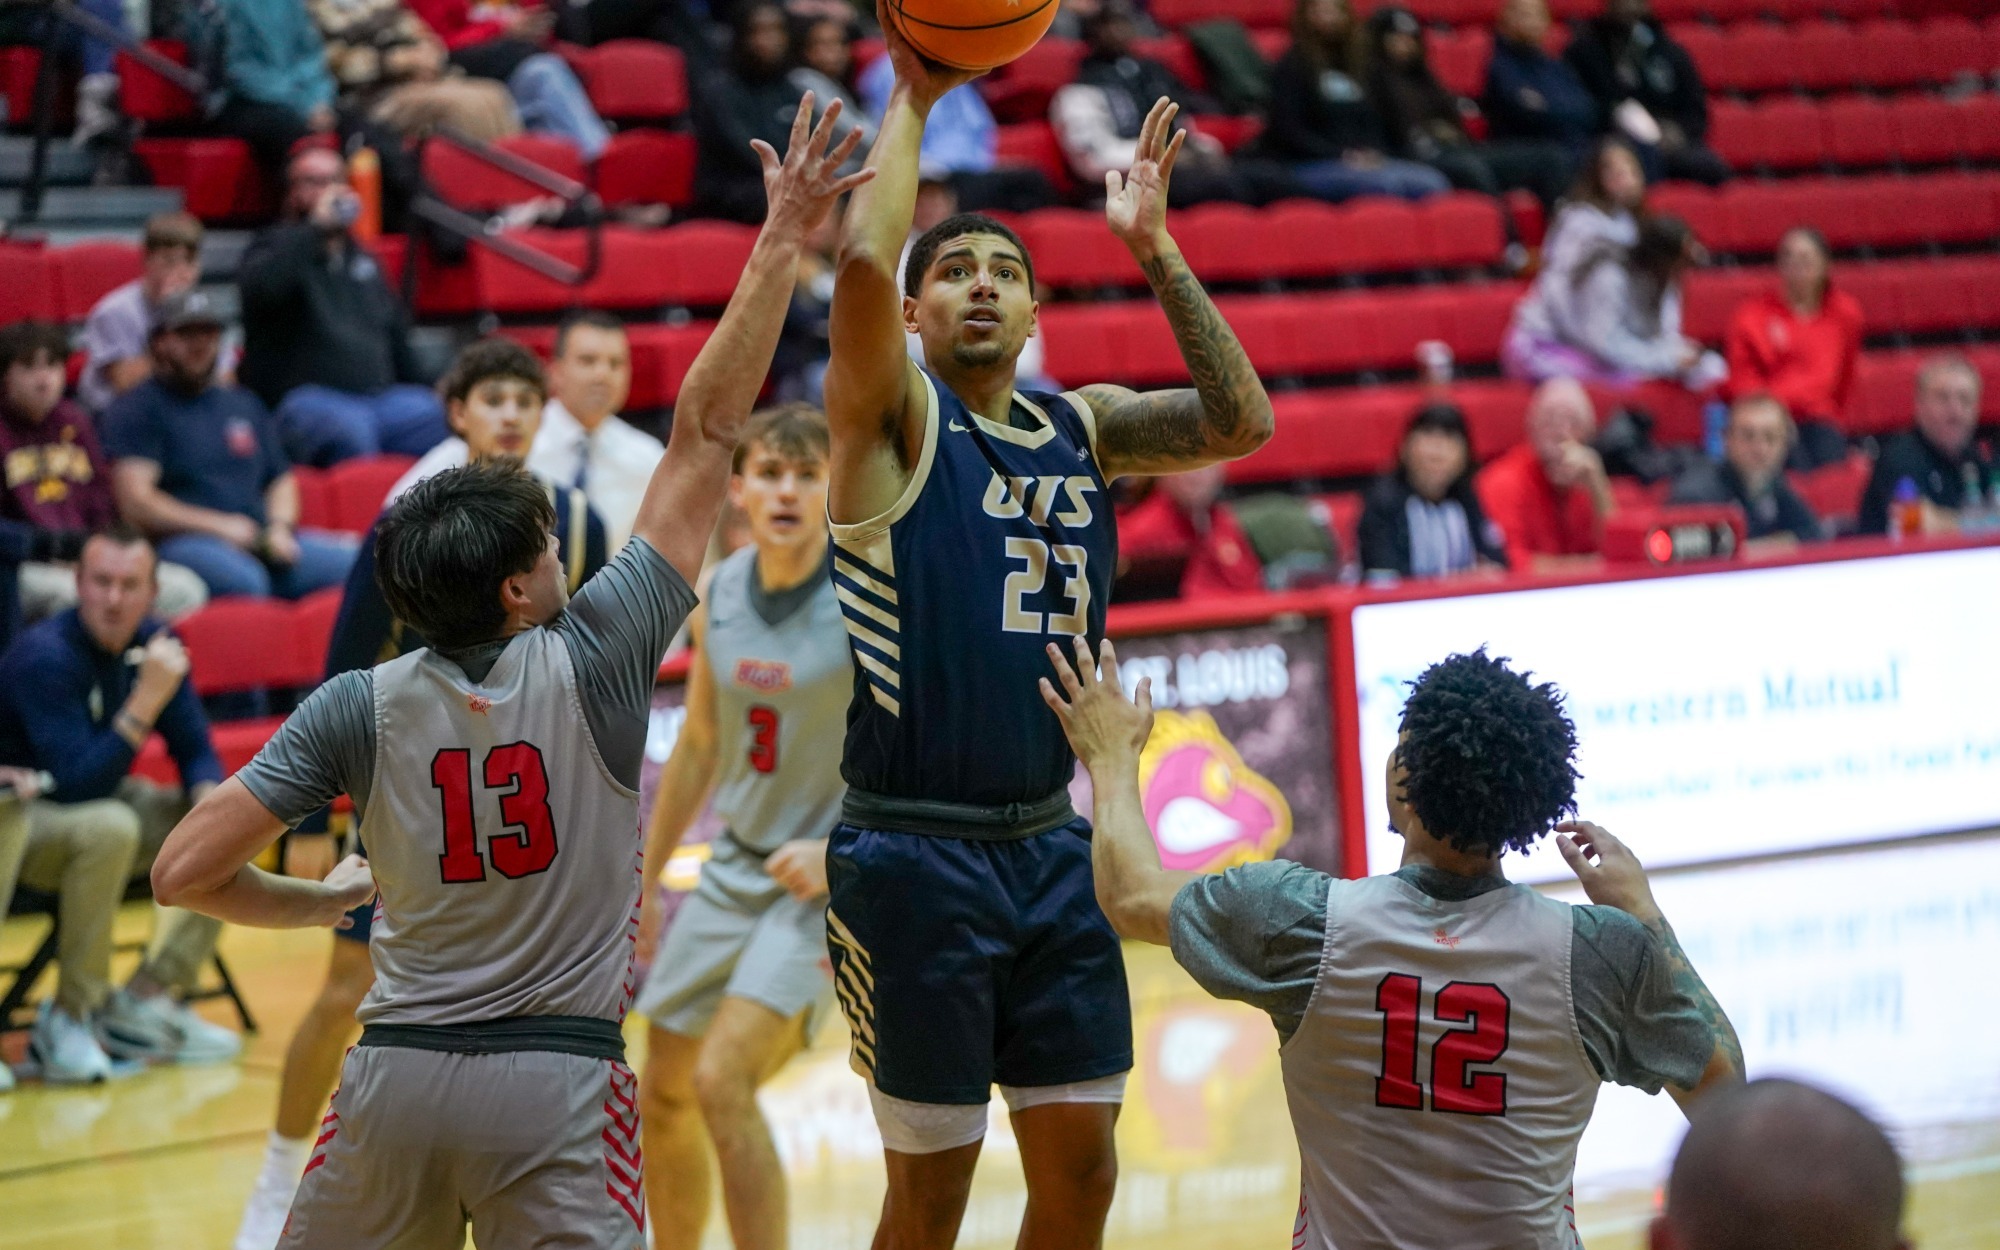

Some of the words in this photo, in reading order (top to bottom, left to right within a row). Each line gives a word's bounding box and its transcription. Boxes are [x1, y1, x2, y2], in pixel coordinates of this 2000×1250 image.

[983, 467, 1098, 528] UIS
[1002, 536, 1091, 636] 23
[1177, 644, 1289, 707] LOUIS
[747, 706, 779, 774] 3
[430, 740, 558, 884] 13
[1375, 972, 1511, 1117] 12
